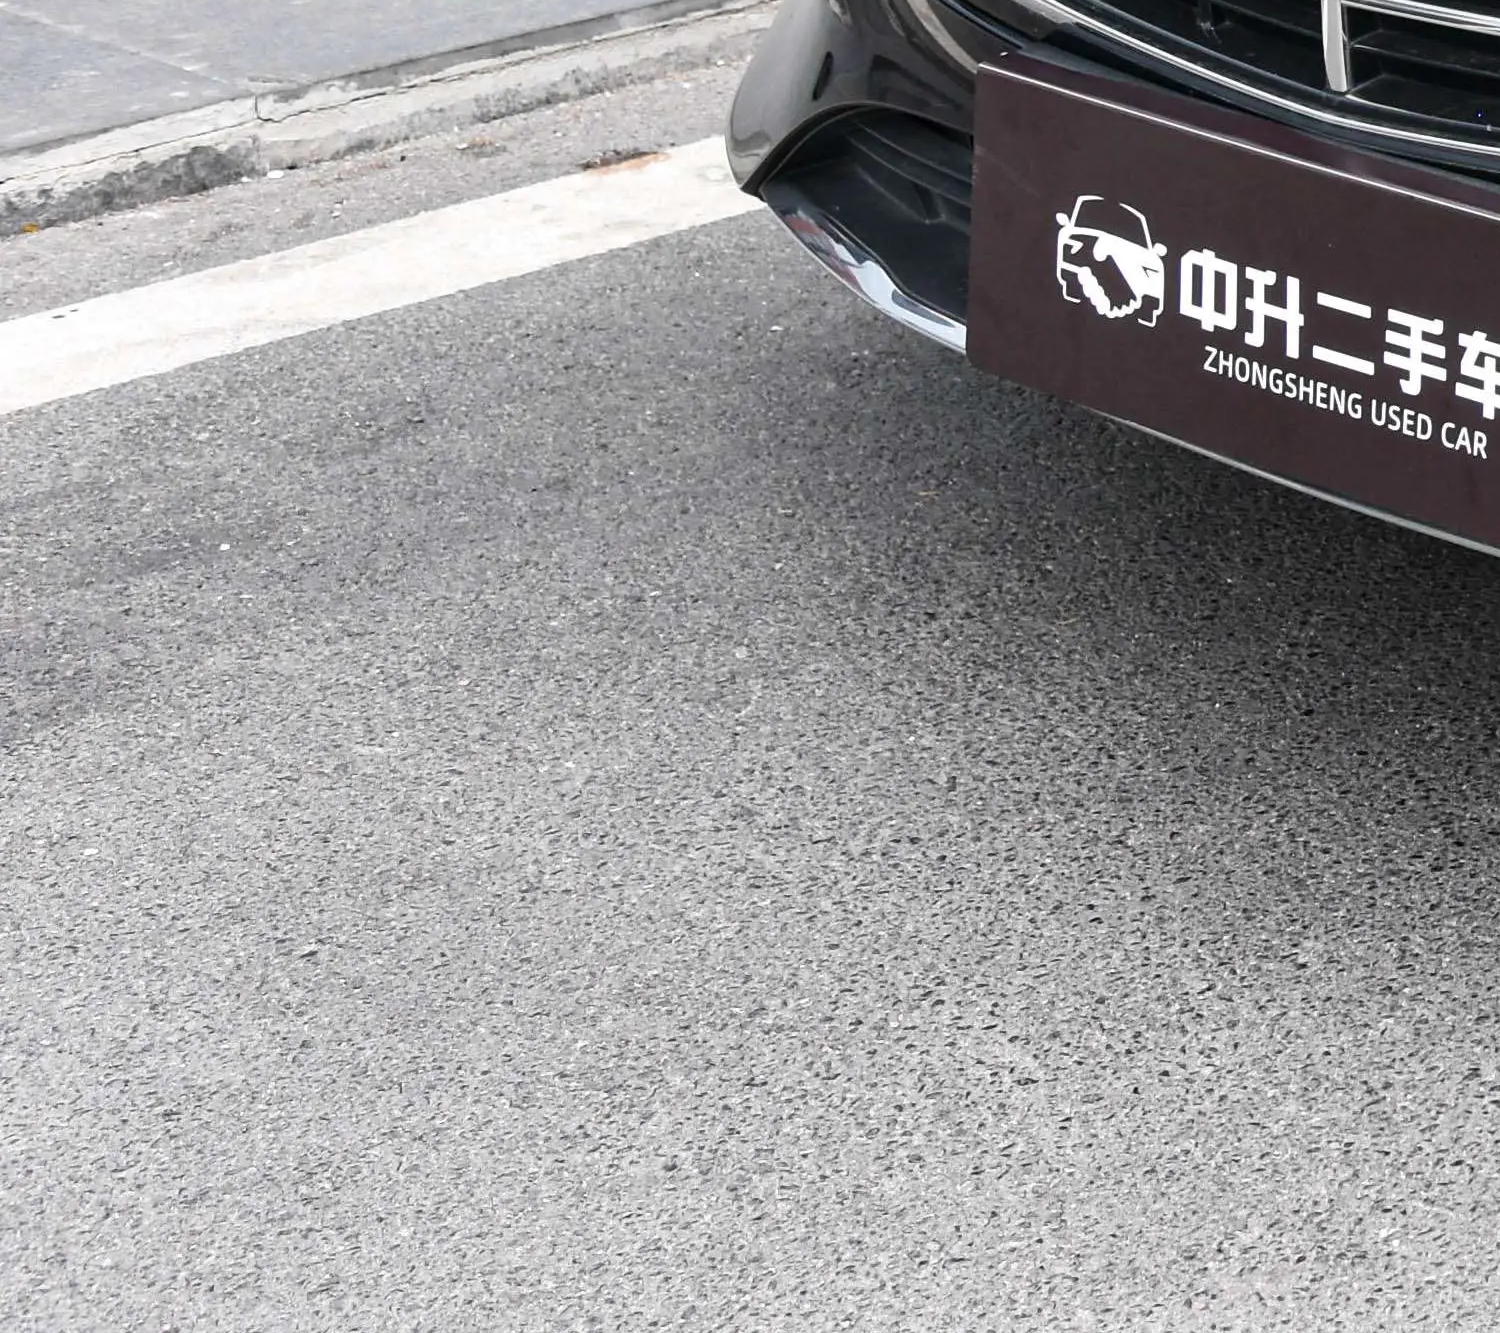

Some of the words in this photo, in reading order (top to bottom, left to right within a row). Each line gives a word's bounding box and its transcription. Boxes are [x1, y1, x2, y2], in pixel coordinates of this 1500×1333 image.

[1203, 344, 1363, 420] ZHONGSHENG
[1369, 399, 1433, 442] USED
[1440, 420, 1488, 460] CAR
